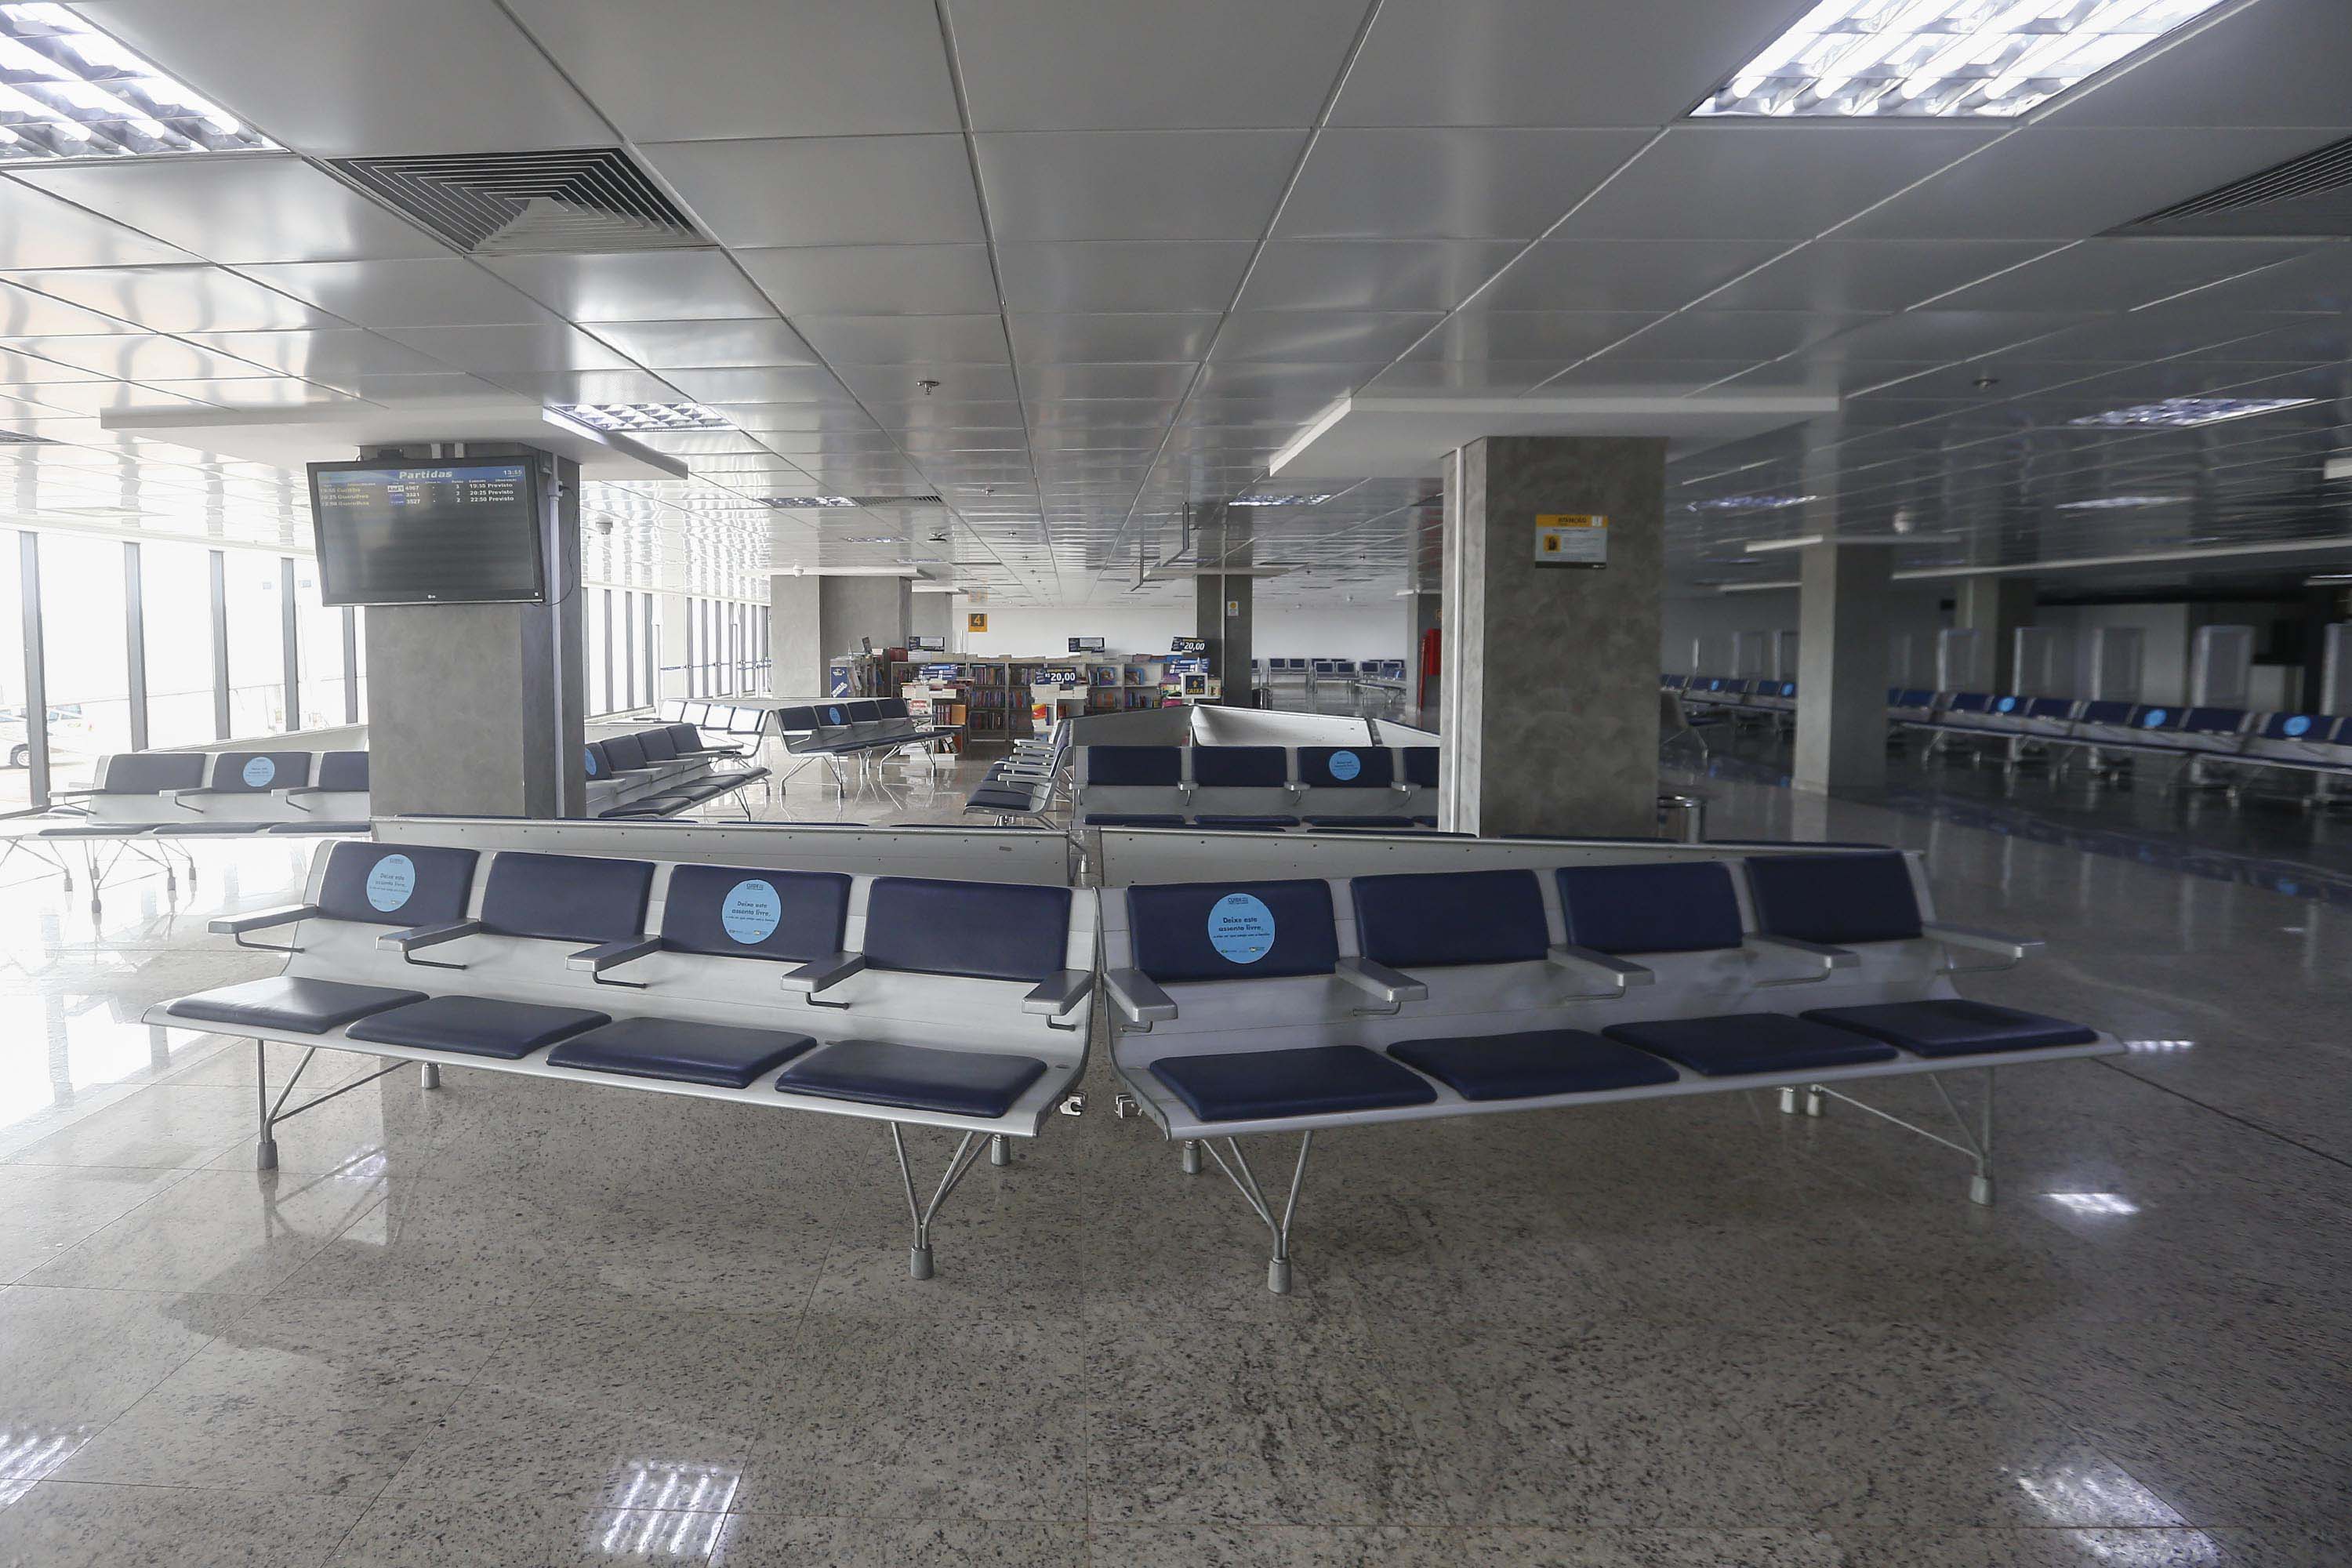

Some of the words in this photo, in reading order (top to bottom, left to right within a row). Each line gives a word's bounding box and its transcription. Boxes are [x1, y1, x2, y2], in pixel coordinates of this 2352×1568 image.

[399, 470, 452, 480] Partidas
[973, 614, 982, 626] 4
[1184, 642, 1205, 651] 20,00
[1051, 672, 1076, 683] 20,00
